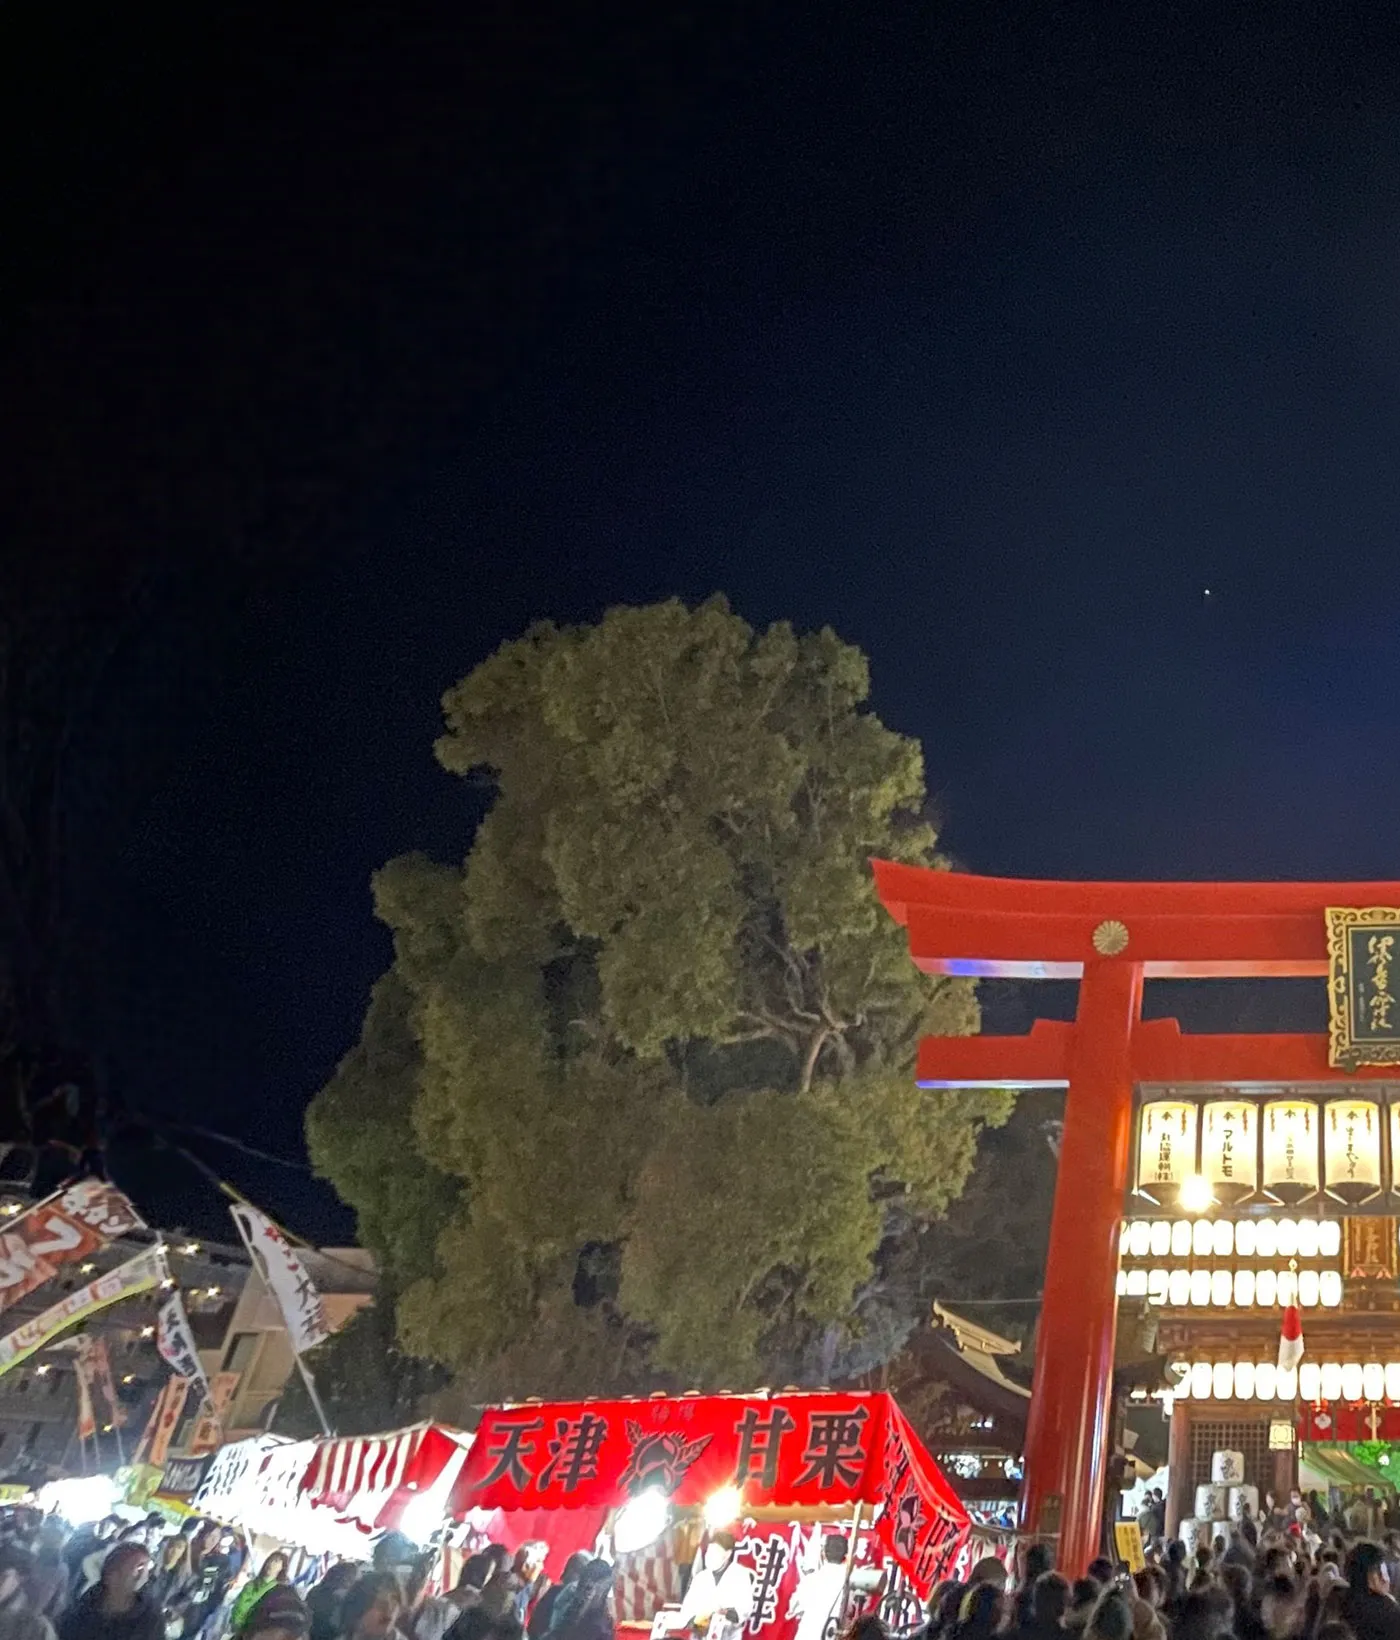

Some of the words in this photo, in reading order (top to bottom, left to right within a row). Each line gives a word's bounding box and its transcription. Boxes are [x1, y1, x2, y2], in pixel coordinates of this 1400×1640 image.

[1222, 1129, 1233, 1177] マルトモ
[473, 1413, 607, 1492] 天津
[733, 1405, 869, 1490] 甘栗
